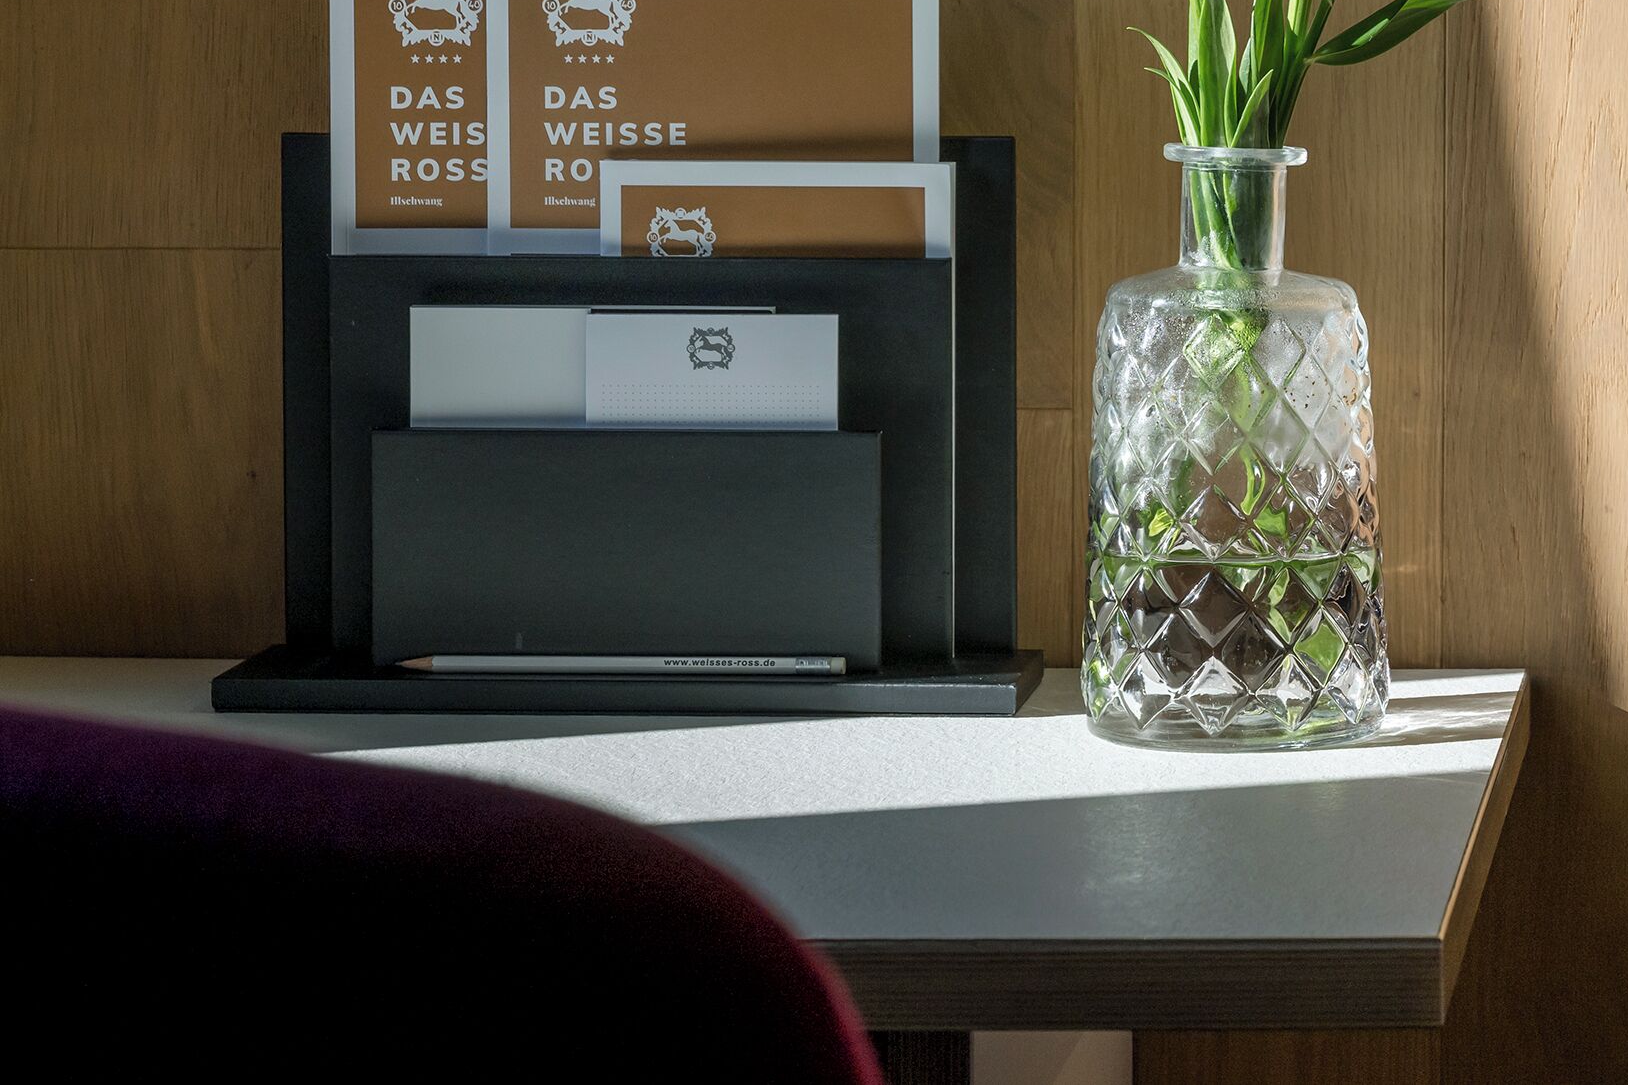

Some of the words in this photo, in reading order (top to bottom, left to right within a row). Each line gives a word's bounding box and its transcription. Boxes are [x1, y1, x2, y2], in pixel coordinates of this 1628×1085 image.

[392, 1, 402, 10] 10
[468, 0, 480, 9] 40
[546, 1, 556, 10] 10
[621, 0, 633, 9] 40
[390, 86, 465, 109] DAS
[544, 86, 618, 109] DAS
[390, 122, 486, 145] WEIS
[543, 122, 687, 145] WEISSE
[391, 158, 488, 181] ROSS
[544, 158, 593, 181] RO
[390, 196, 443, 207] Illschwang
[544, 196, 596, 207] Illschwang
[663, 658, 776, 667] www.weisses-ross.de
